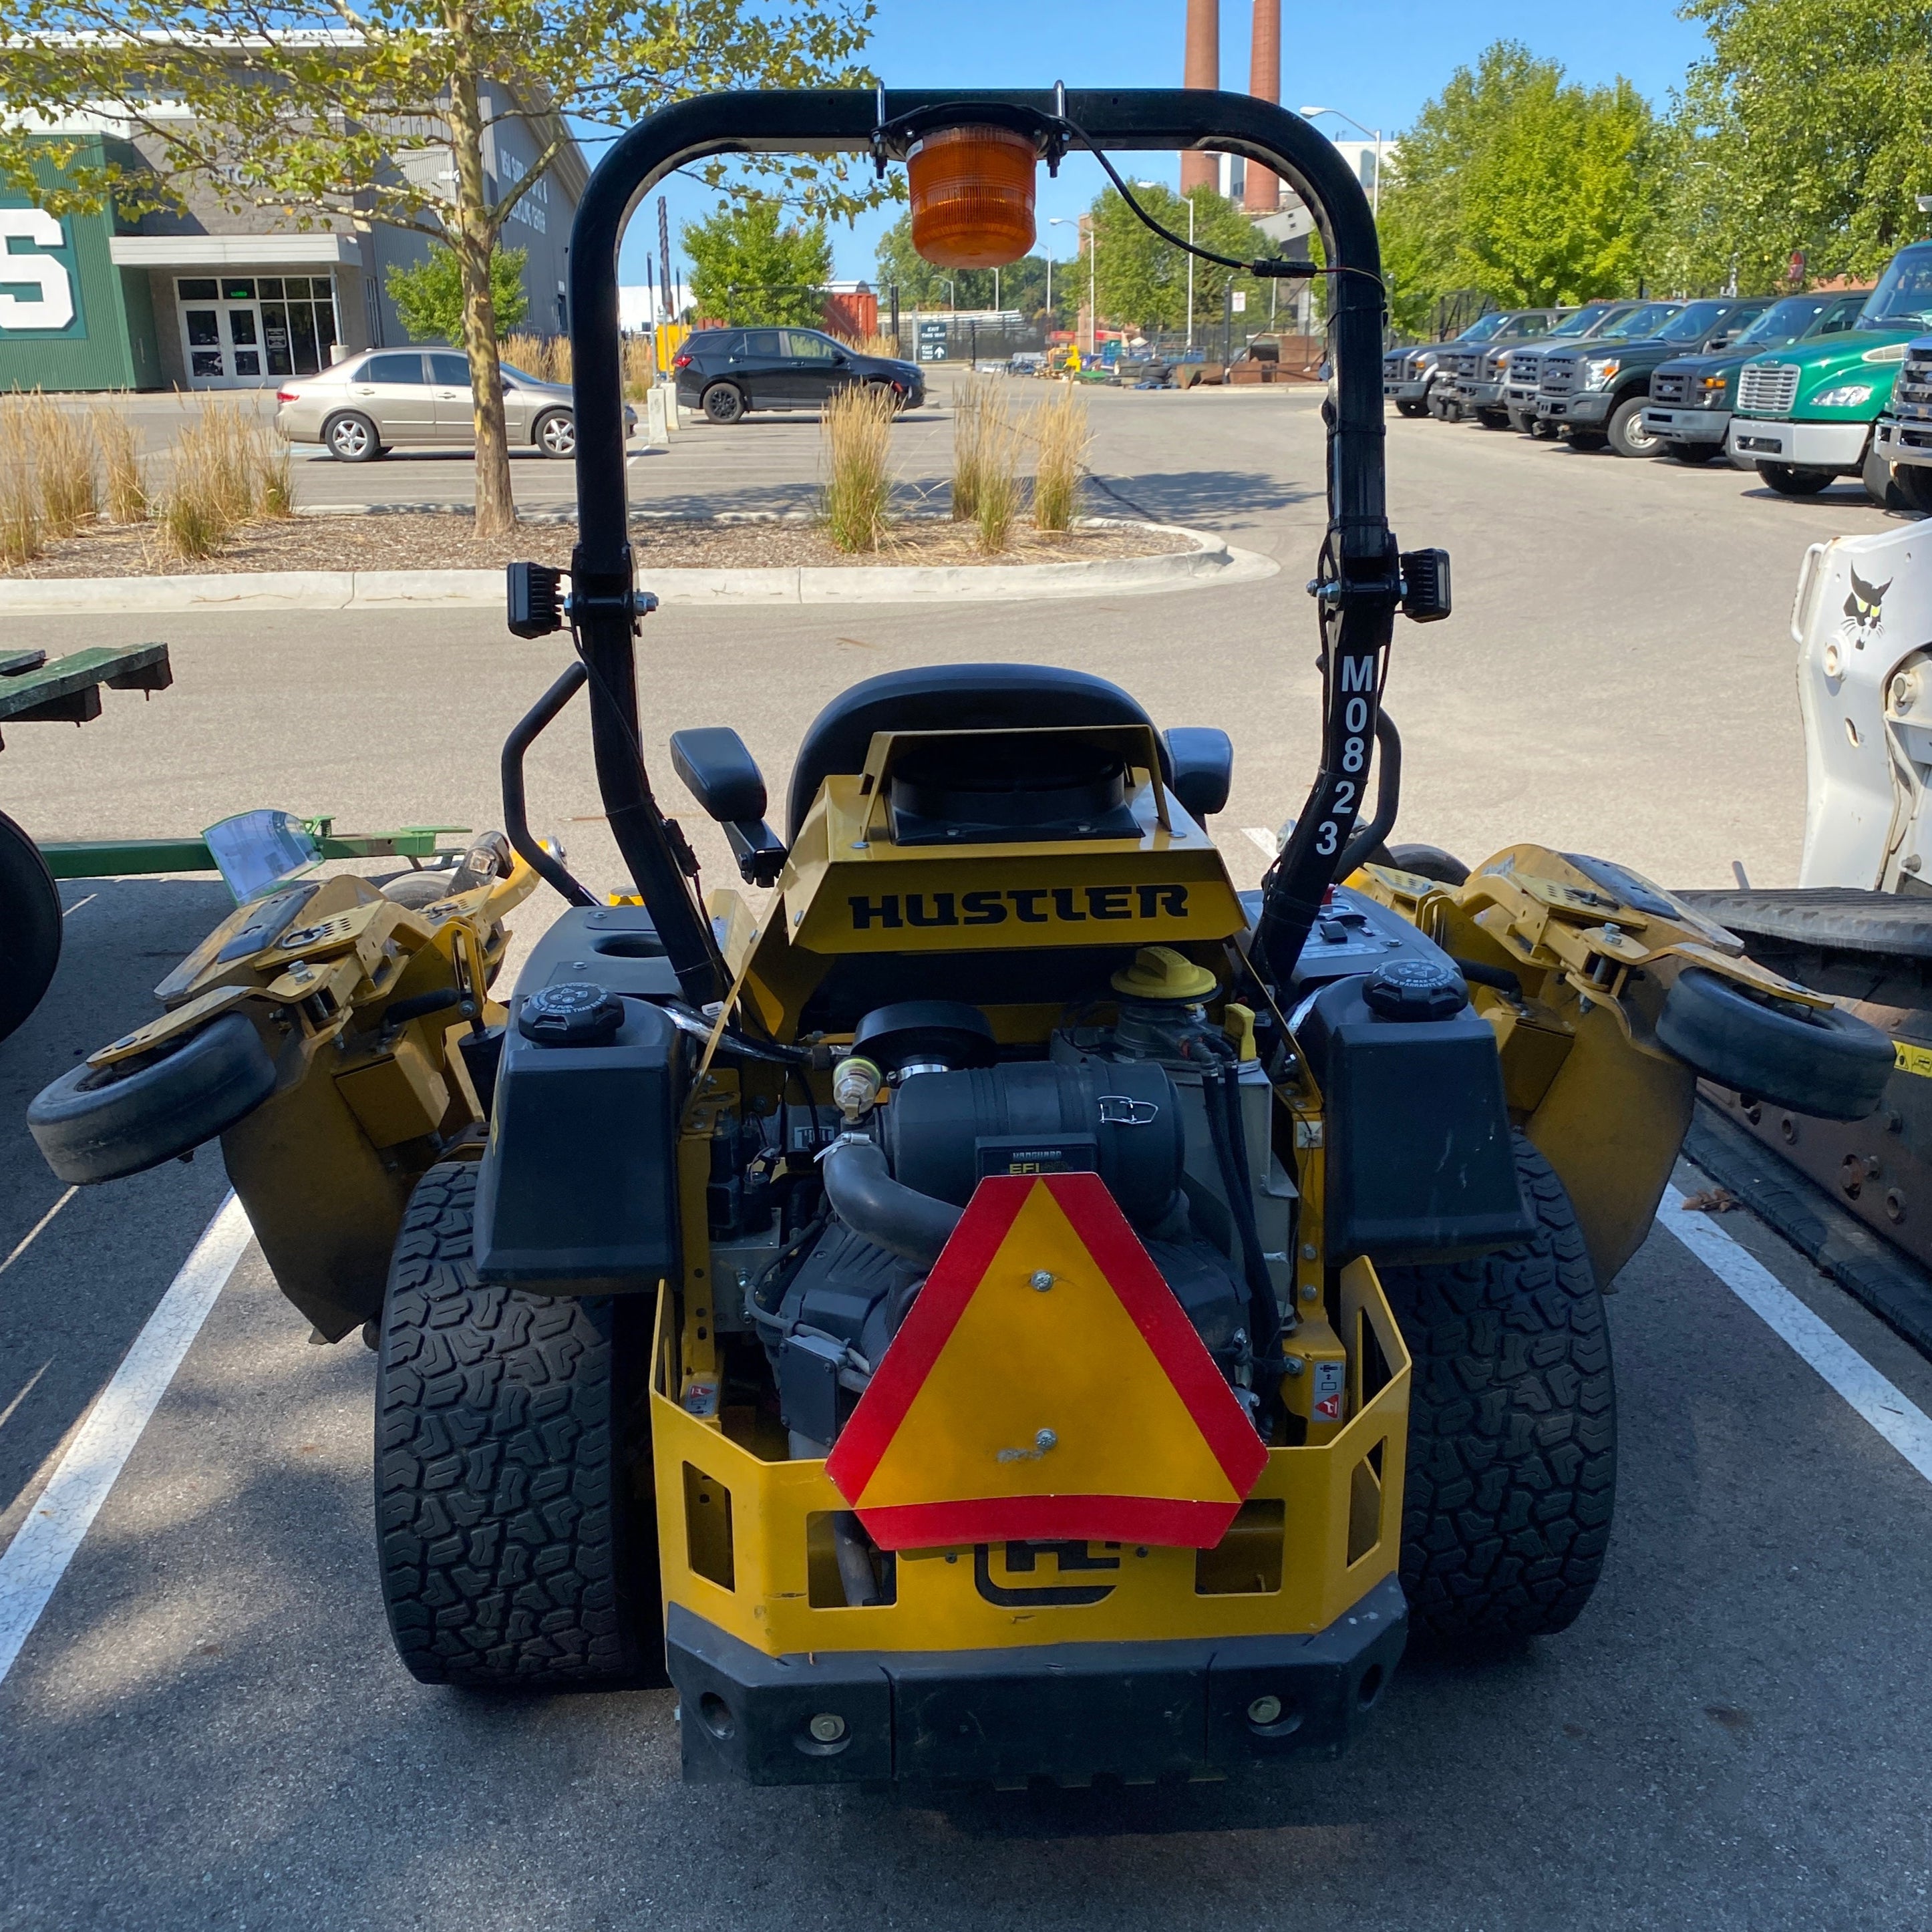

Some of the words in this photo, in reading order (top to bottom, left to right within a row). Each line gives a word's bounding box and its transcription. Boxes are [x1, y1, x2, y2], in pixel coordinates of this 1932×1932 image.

[0, 208, 73, 328] S
[1316, 655, 1374, 855] M0823
[848, 884, 1188, 929] HUSTLER
[1009, 1162, 1040, 1174] EFI
[1013, 1151, 1062, 1160] VANGUARD
